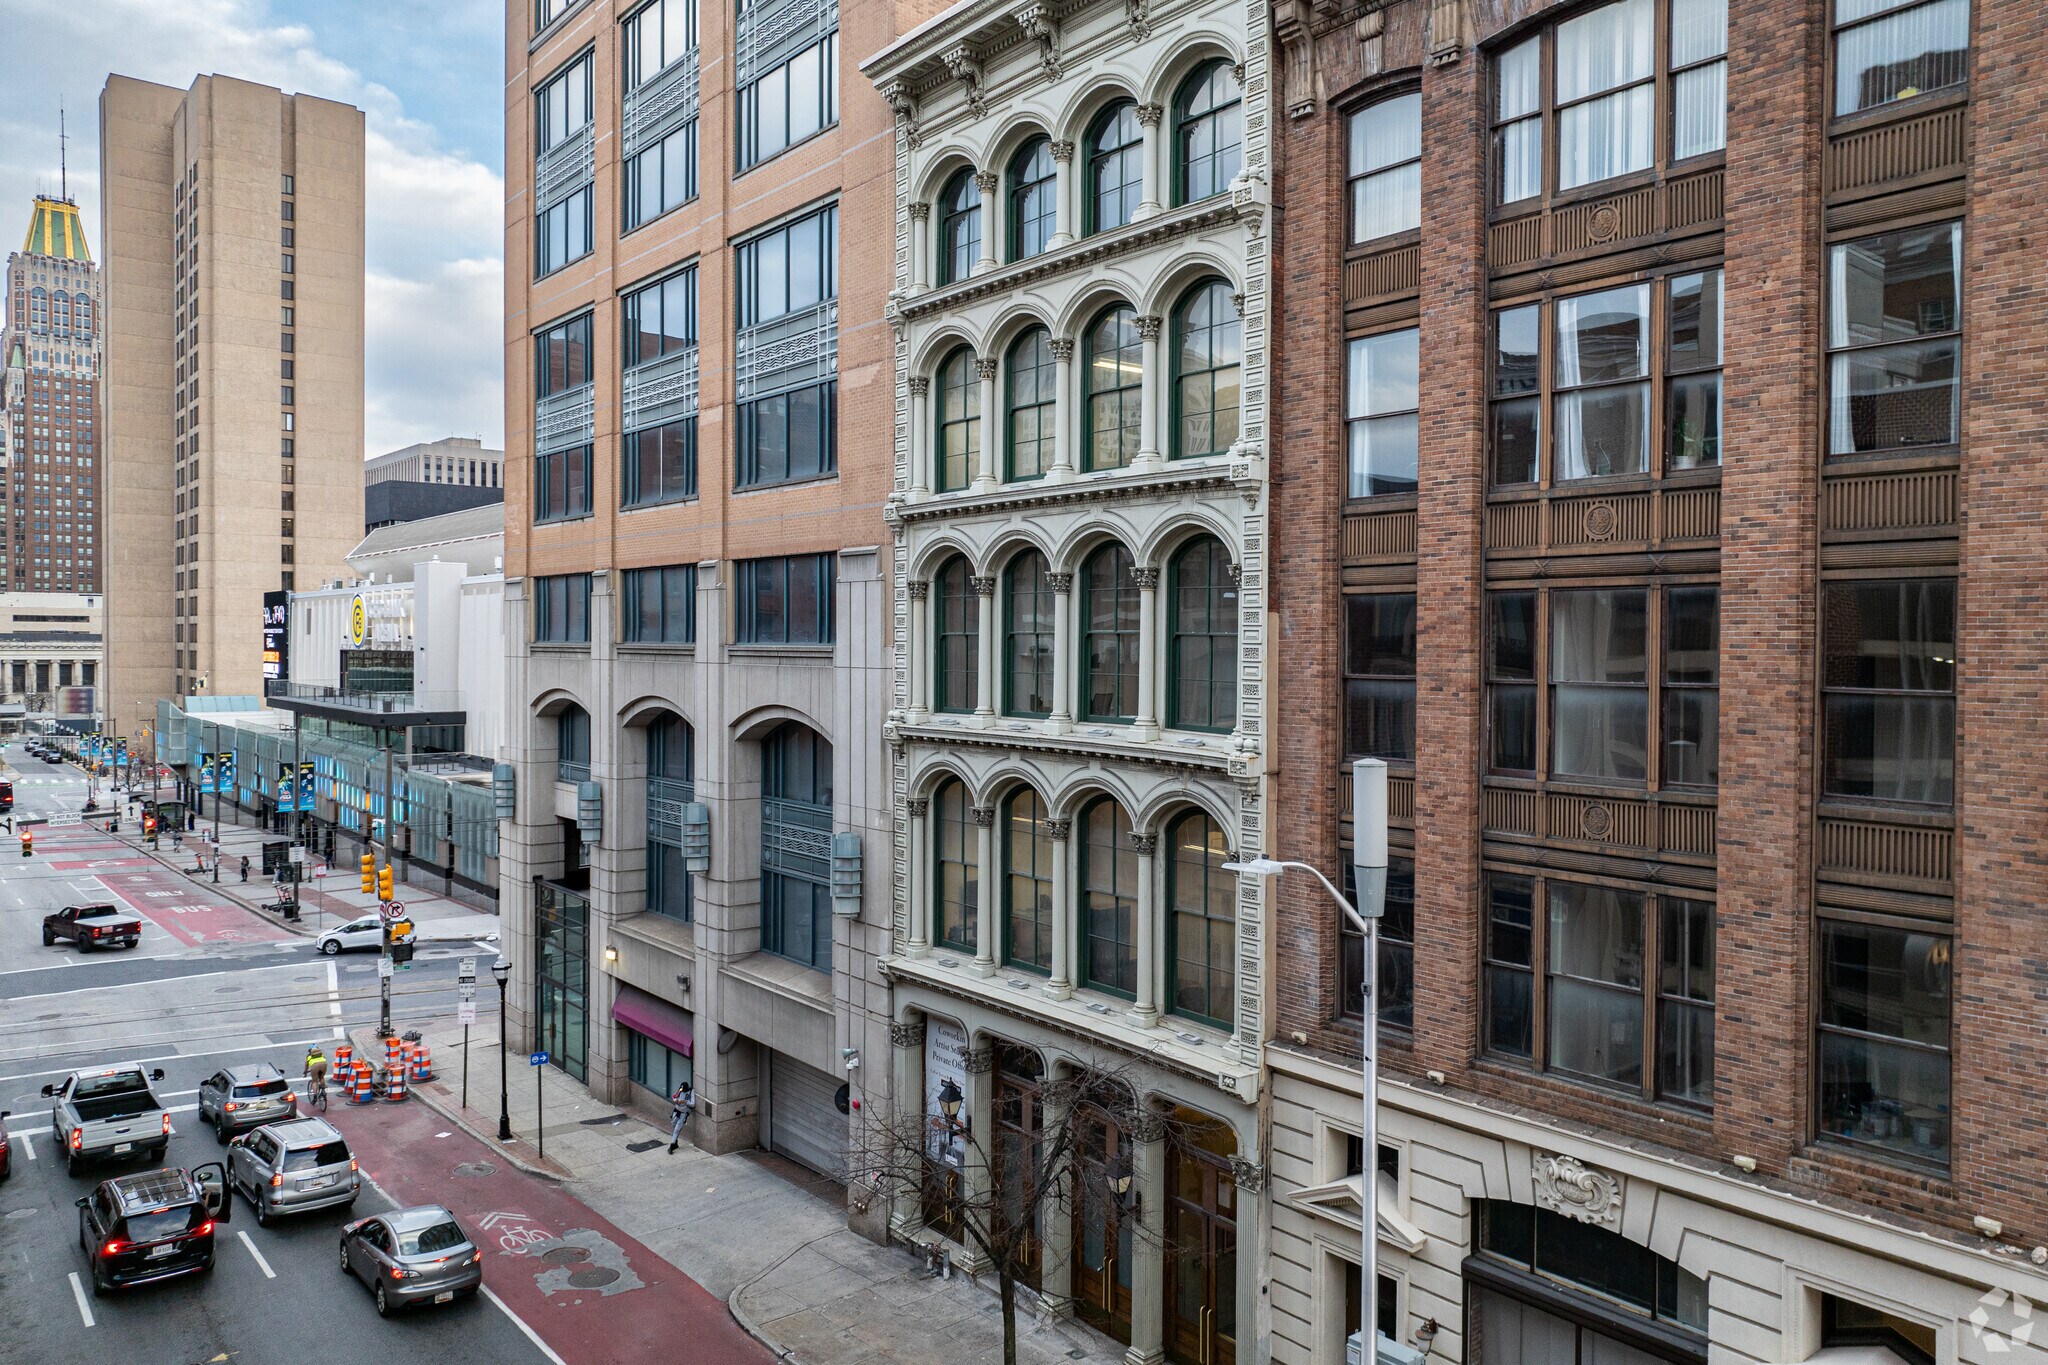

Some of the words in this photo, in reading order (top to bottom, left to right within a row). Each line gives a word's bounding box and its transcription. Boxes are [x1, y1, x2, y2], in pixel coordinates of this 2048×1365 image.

[171, 905, 213, 914] BUS
[938, 1025, 966, 1043] Coworkin
[933, 1038, 950, 1052] Artist
[932, 1050, 951, 1066] Private
